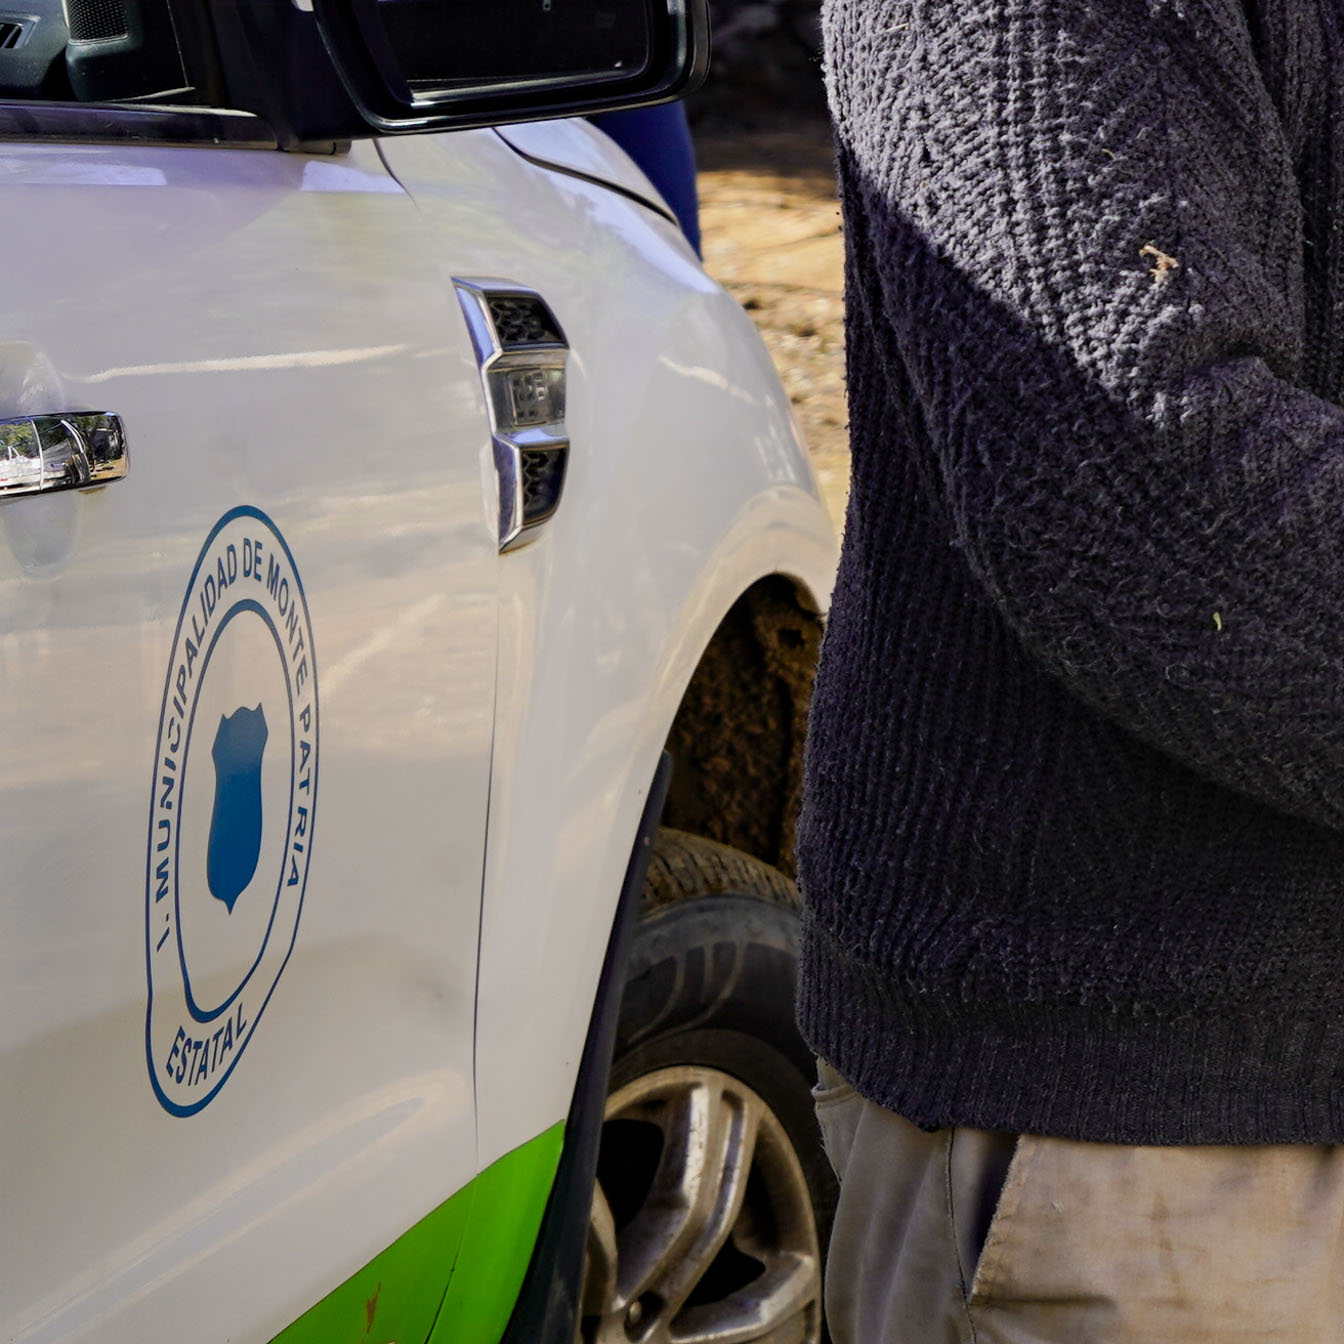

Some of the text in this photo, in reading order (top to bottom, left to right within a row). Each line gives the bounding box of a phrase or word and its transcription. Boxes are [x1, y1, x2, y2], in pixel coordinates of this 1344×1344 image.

[156, 543, 237, 903] MUNICIPALIDAD
[243, 537, 263, 583] DE
[266, 552, 308, 696] MONTE
[287, 703, 311, 887] PATRIA
[166, 1002, 247, 1087] ESTATAL
